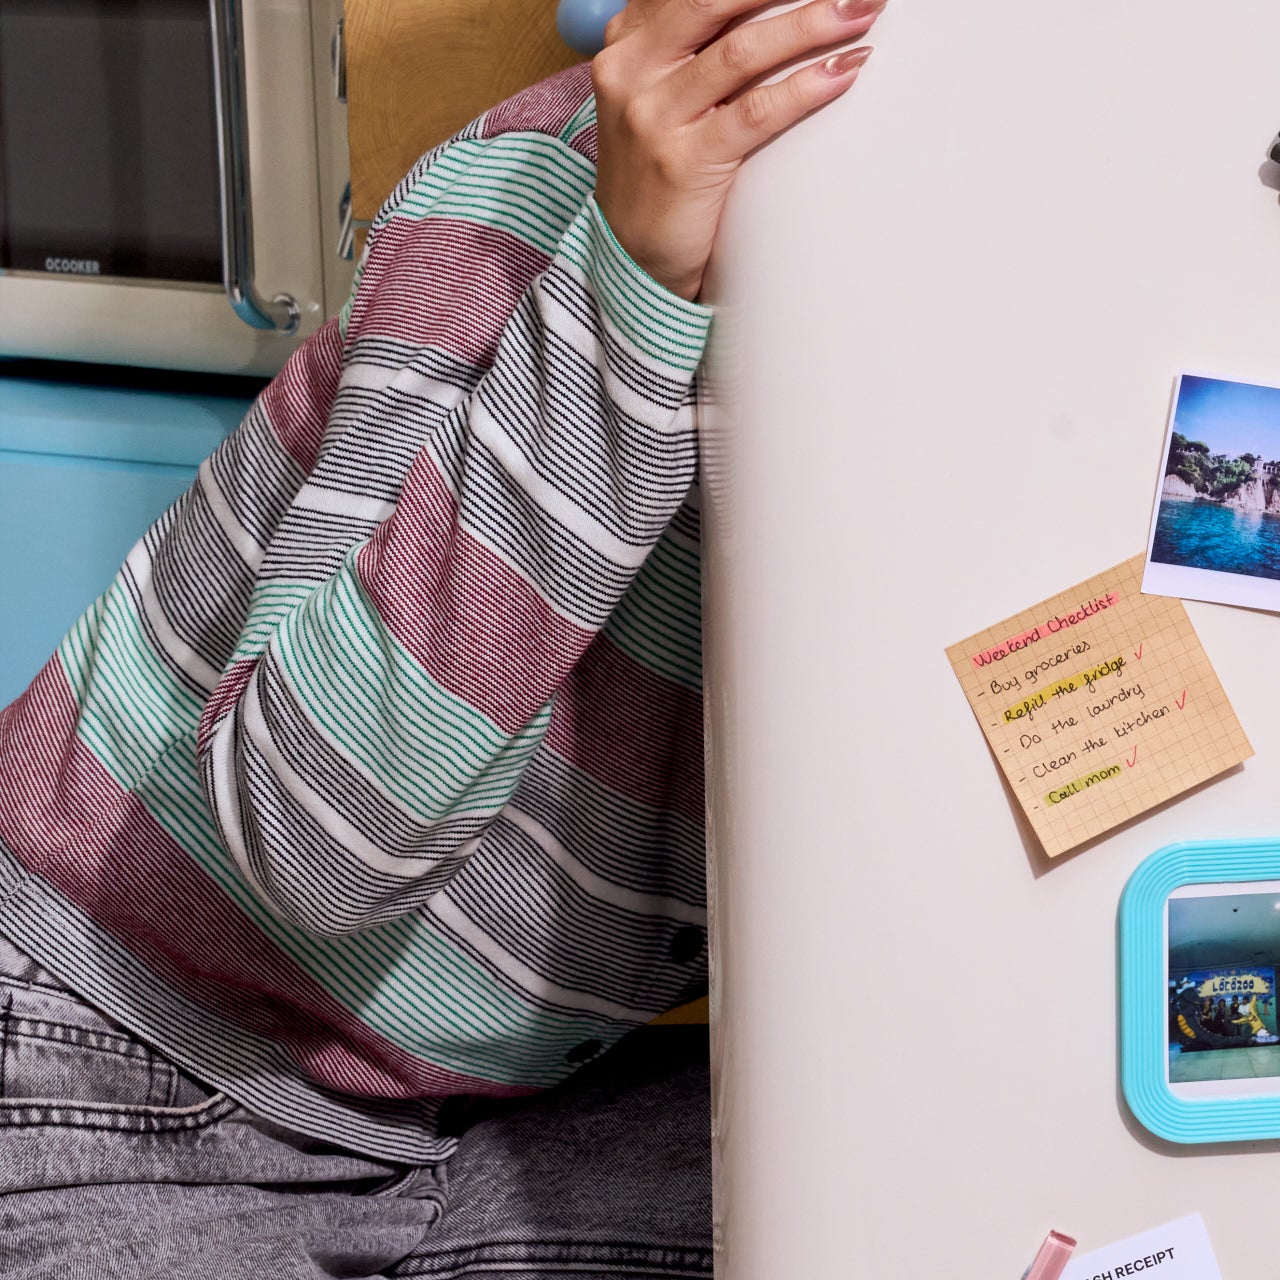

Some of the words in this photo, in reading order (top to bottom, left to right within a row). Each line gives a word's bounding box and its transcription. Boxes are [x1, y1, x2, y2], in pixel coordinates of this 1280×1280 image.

[45, 257, 100, 274] OCOOKER
[974, 628, 1041, 667] Weekend
[1047, 594, 1114, 632] Checklist
[990, 676, 1022, 694] Buy
[1025, 641, 1091, 684] groceries
[1004, 694, 1047, 722] Refill
[1052, 682, 1078, 699] the
[1084, 656, 1127, 693] fridge
[1020, 734, 1042, 749] Do
[1051, 716, 1078, 734] the
[1033, 751, 1077, 778] Clean
[1082, 737, 1107, 753] the
[1114, 705, 1170, 738] kitchen
[1049, 785, 1081, 803] Call
[1085, 765, 1120, 788] mom
[1114, 1247, 1175, 1279] RECEIPT
